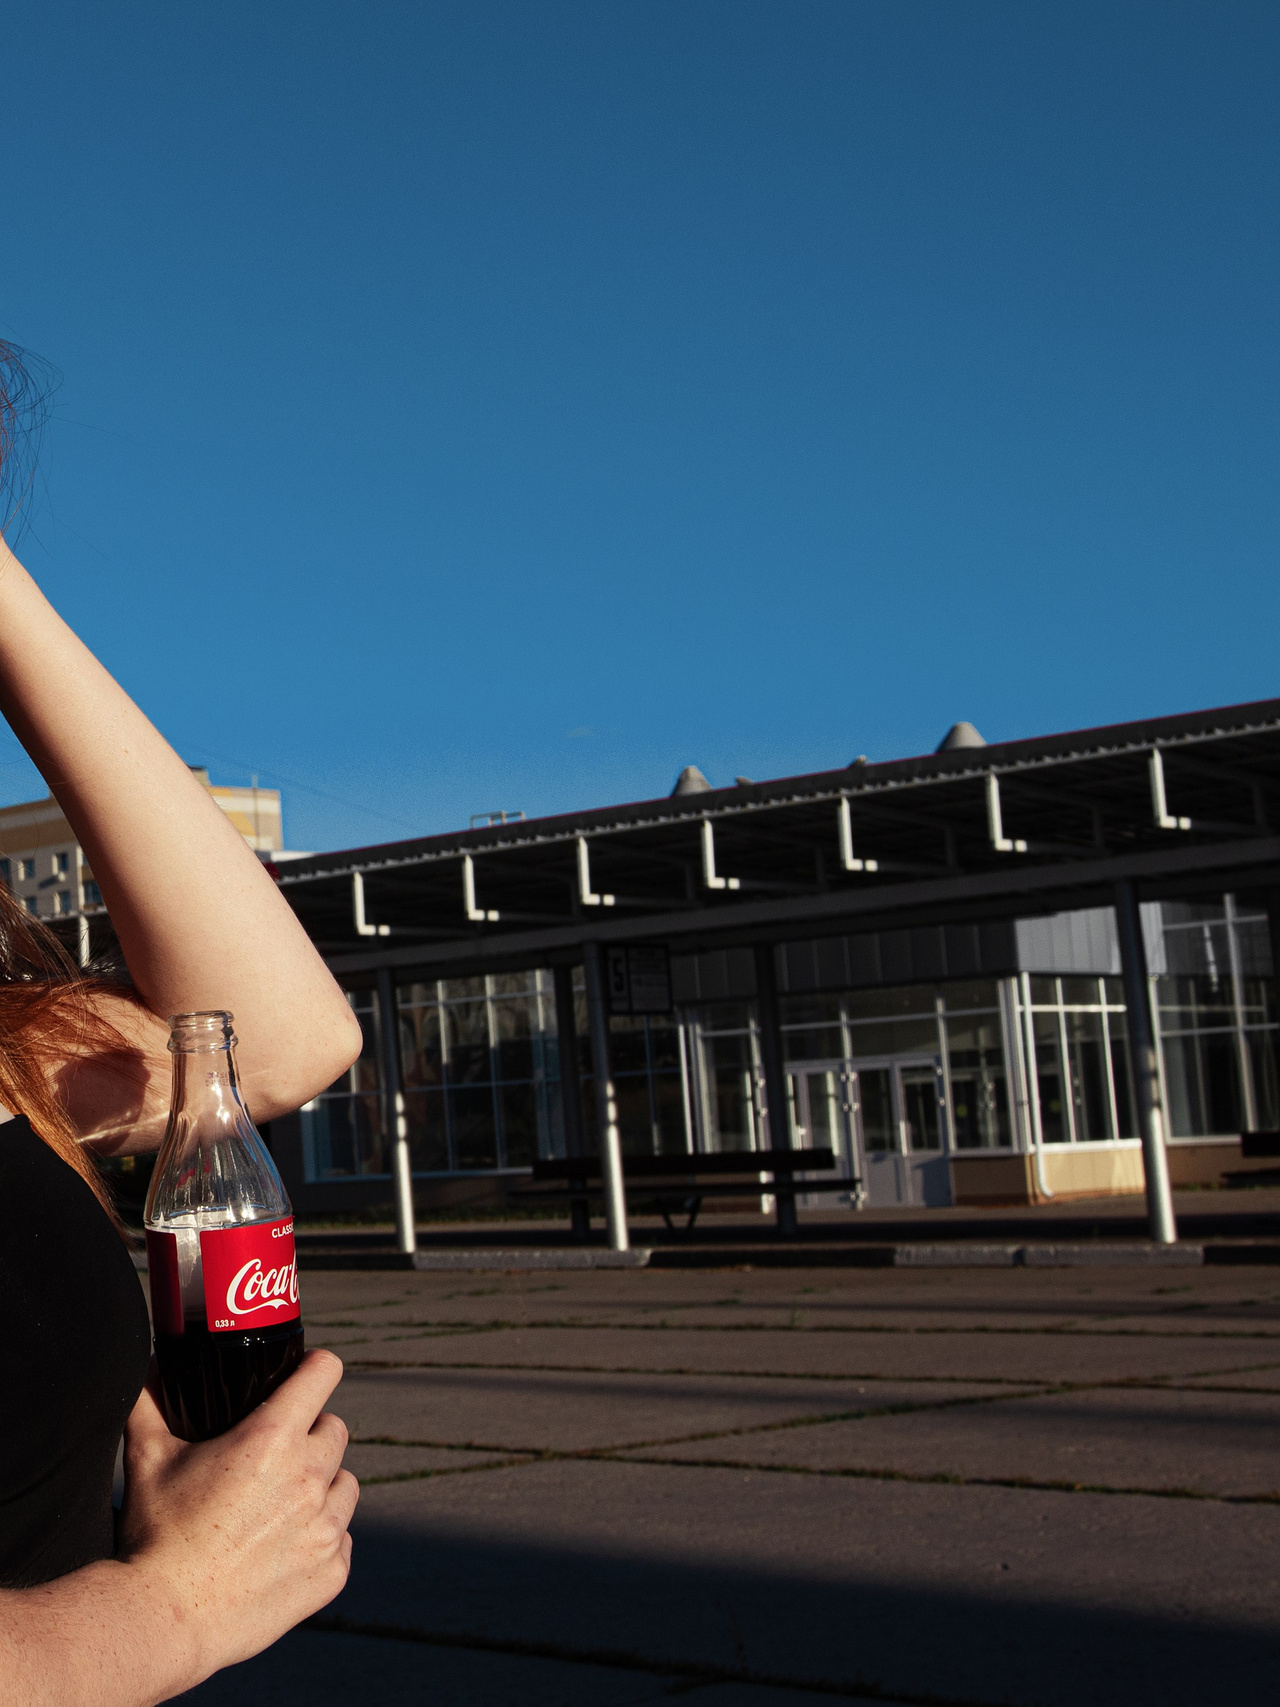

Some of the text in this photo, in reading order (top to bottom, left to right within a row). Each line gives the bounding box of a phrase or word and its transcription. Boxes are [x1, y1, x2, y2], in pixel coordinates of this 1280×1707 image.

[271, 1222, 295, 1239] CLASSI
[226, 1249, 300, 1315] Coca-C
[215, 1319, 230, 1328] 0,33
